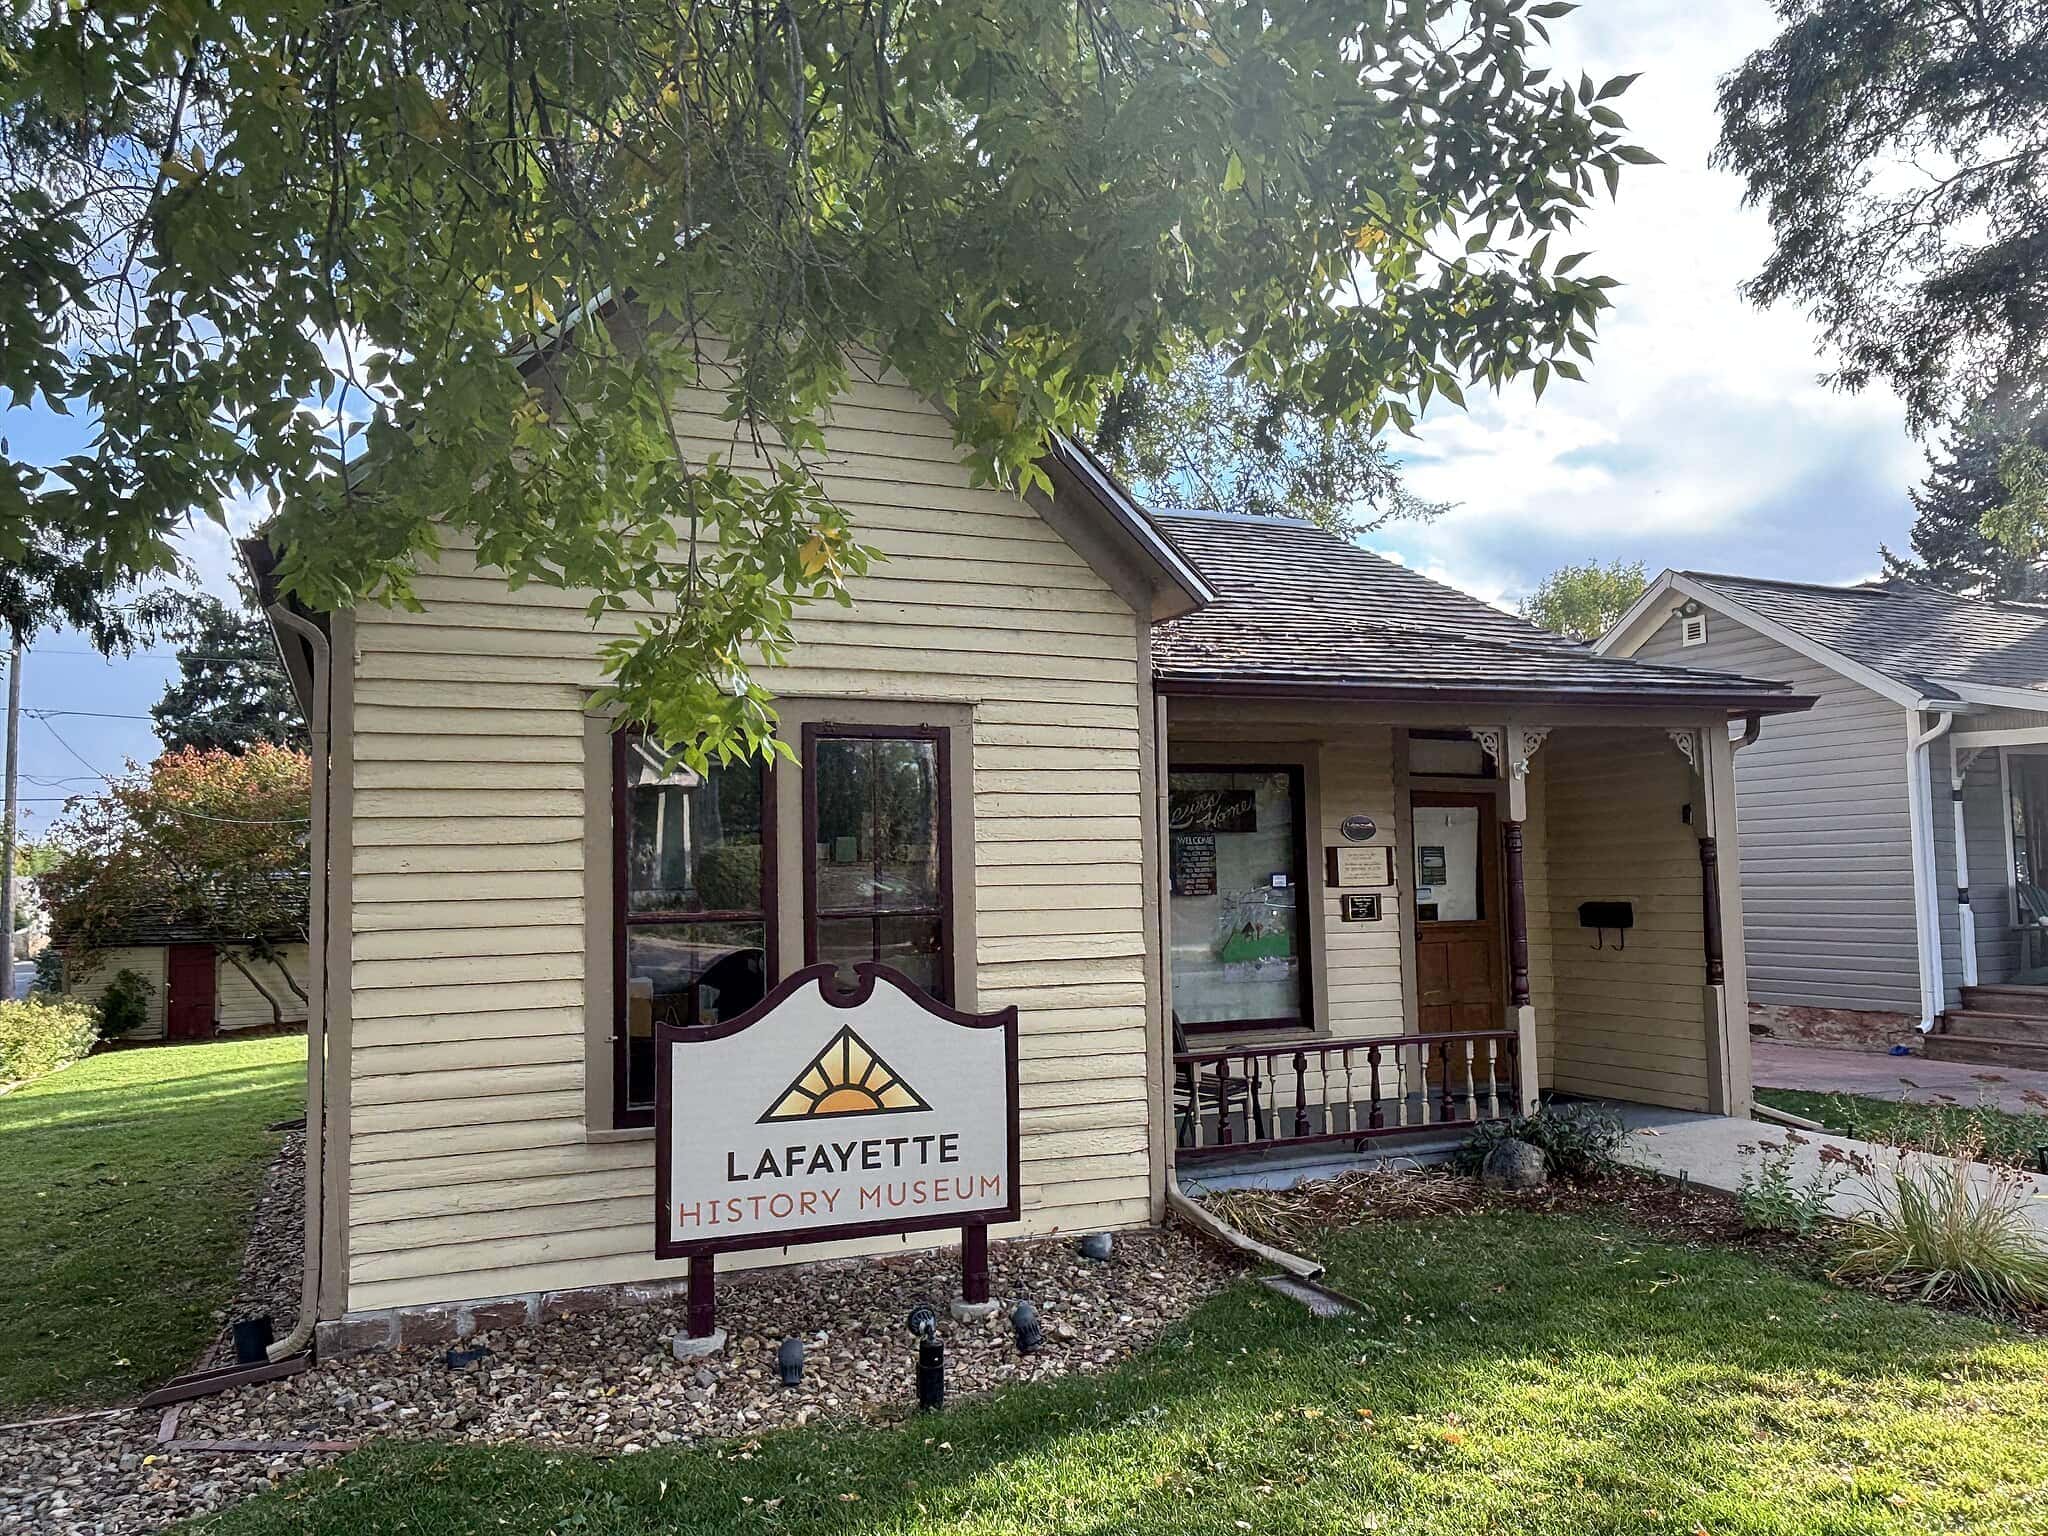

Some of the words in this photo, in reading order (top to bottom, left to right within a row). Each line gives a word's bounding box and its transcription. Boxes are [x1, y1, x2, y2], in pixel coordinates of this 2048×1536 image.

[1196, 795, 1252, 828] Home
[1177, 835, 1214, 845] WELCOME
[727, 1133, 960, 1182] LAFAYETTE
[679, 1187, 841, 1228] HISTORY
[859, 1174, 1001, 1210] MUSEUM
